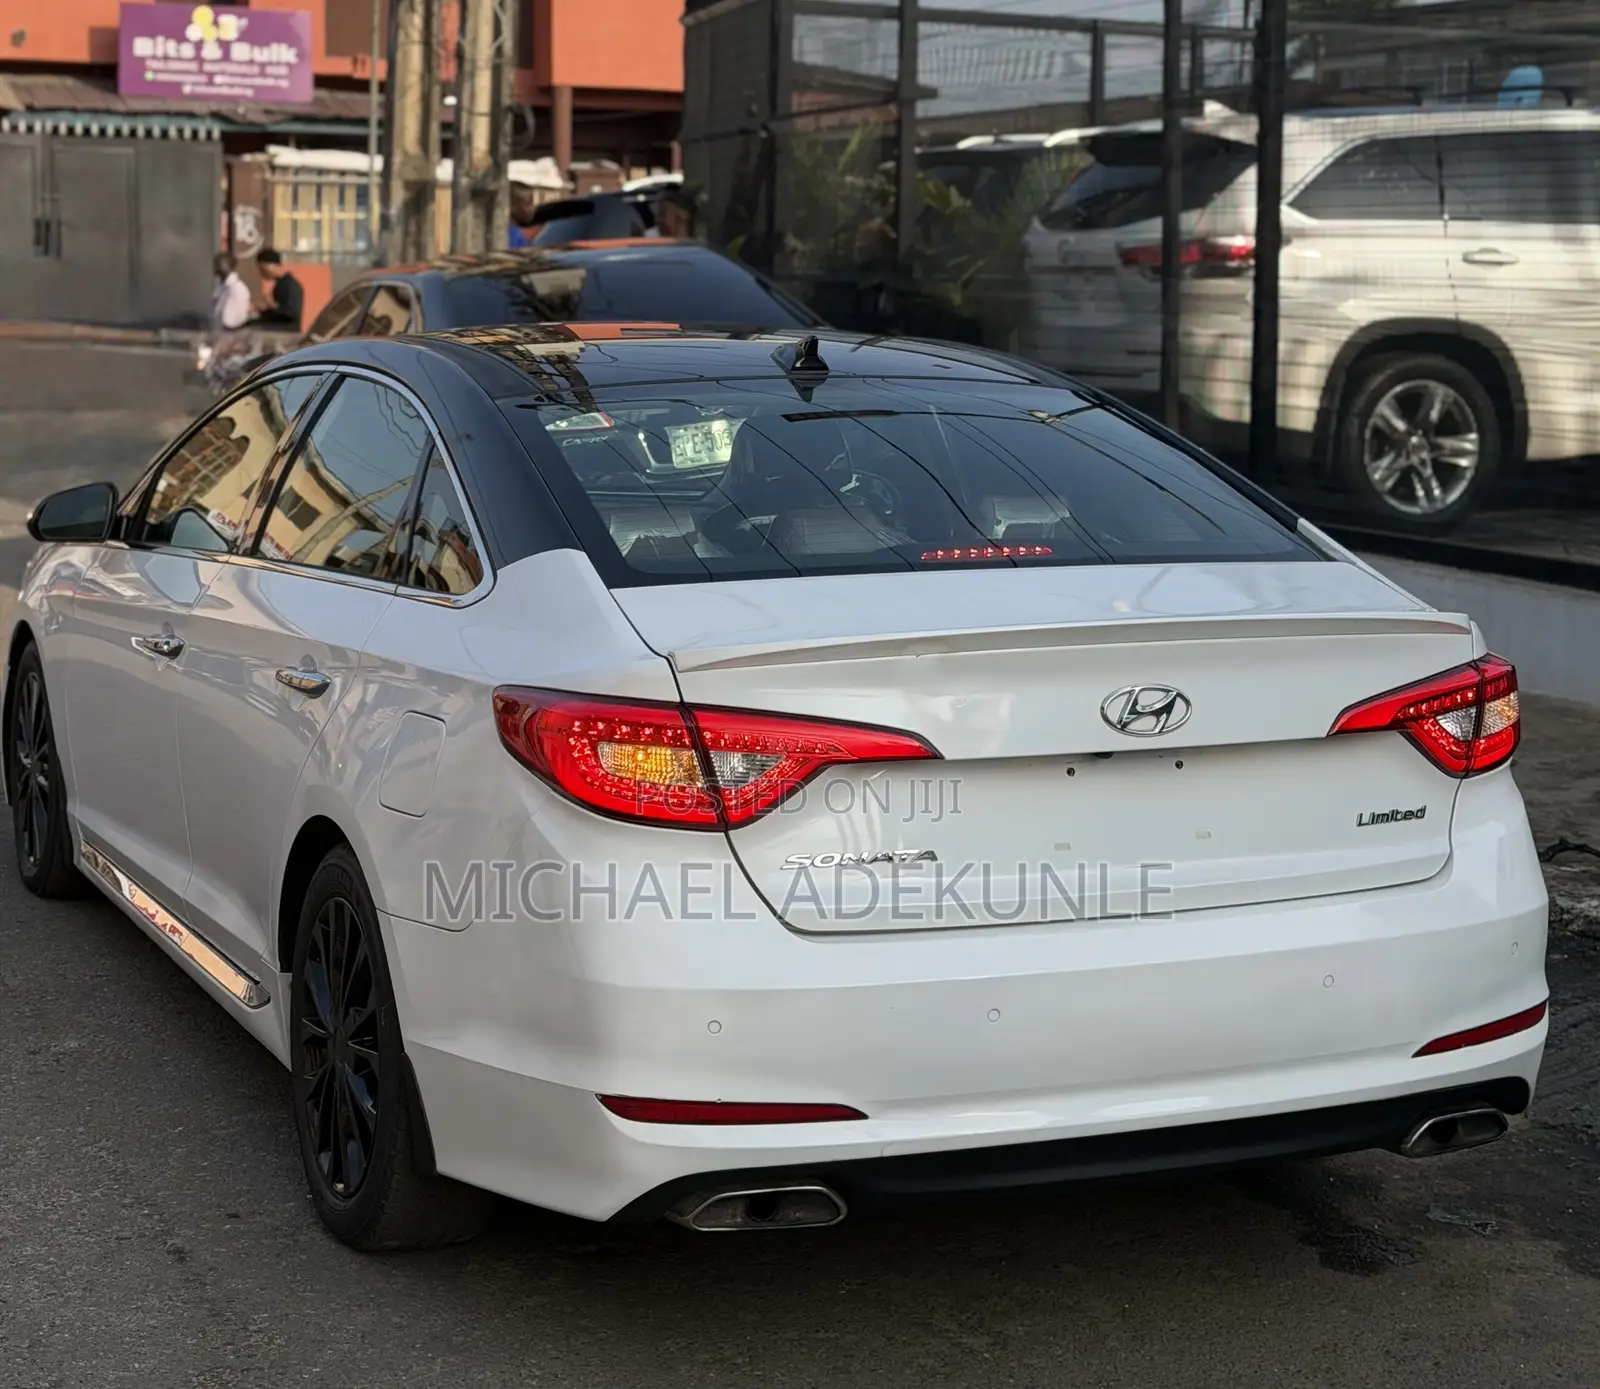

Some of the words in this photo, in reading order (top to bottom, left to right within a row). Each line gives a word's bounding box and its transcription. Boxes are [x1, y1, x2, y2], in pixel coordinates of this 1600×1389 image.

[133, 36, 195, 58] Bits
[230, 42, 298, 64] Bulk
[1355, 804, 1427, 827] Limited
[780, 849, 939, 870] SONATA
